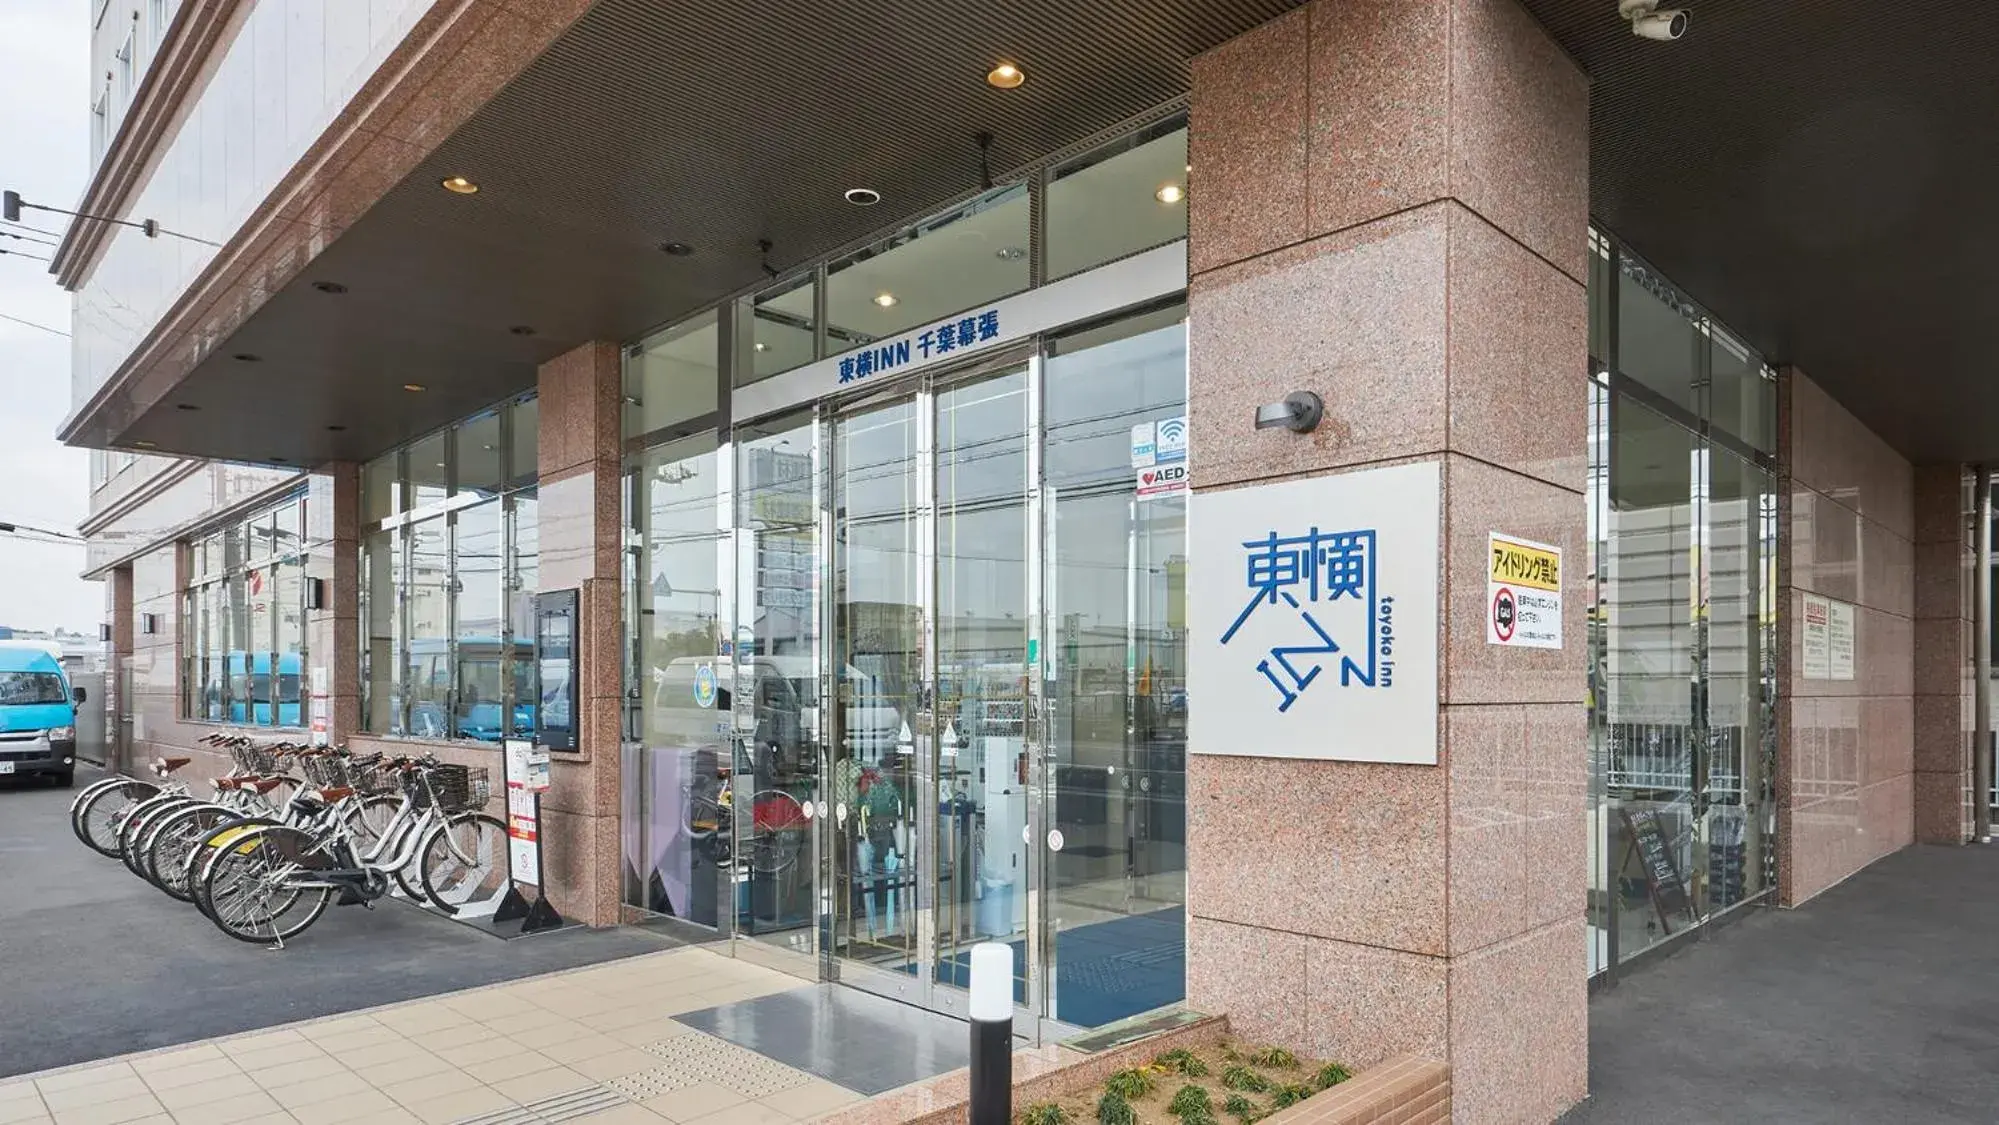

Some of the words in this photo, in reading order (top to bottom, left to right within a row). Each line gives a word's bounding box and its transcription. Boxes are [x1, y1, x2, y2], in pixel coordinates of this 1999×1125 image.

[839, 340, 910, 384] 東横INN
[917, 310, 999, 359] 千葉幕張
[1154, 466, 1185, 482] AED
[1494, 549, 1558, 585] アイドリング禁止
[1378, 596, 1395, 656] toyoko
[1380, 661, 1395, 688] inn
